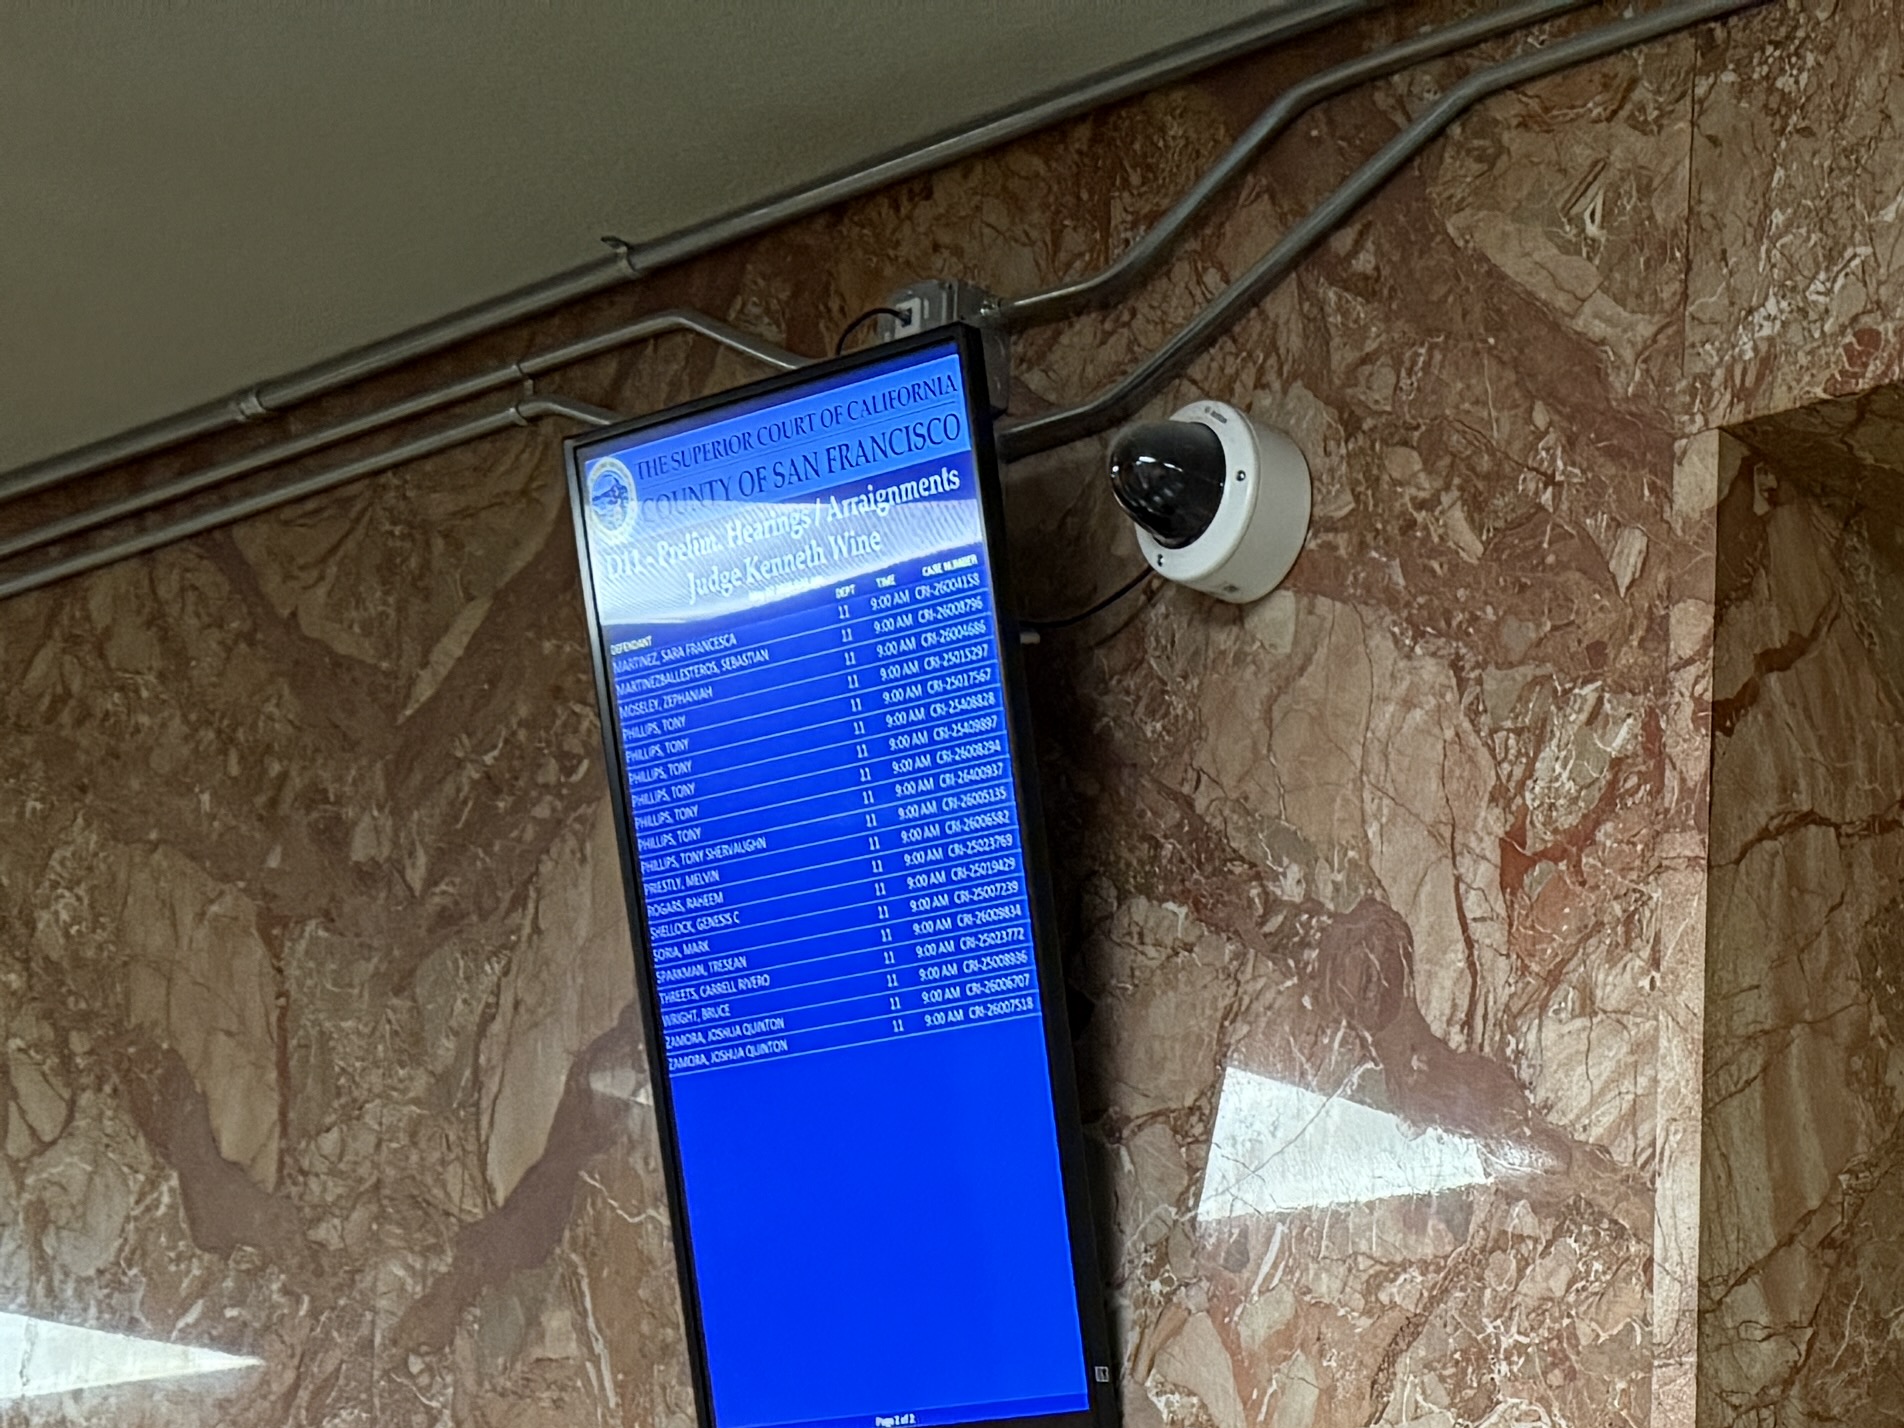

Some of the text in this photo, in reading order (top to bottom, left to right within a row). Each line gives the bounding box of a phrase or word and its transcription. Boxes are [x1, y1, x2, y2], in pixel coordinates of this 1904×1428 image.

[638, 374, 957, 480] THE SUPERIOR COURT OF CALIFORNIA
[641, 413, 960, 523] COUNTY OF SAN FRANCISCO
[725, 508, 812, 549] Hearings
[827, 466, 960, 523] Arraignments
[687, 565, 742, 605] Judge
[743, 539, 823, 585] Kenneth
[828, 531, 880, 561] Wine
[838, 605, 849, 619] 11
[893, 589, 910, 605] AM
[686, 633, 737, 656] FRANCESCA
